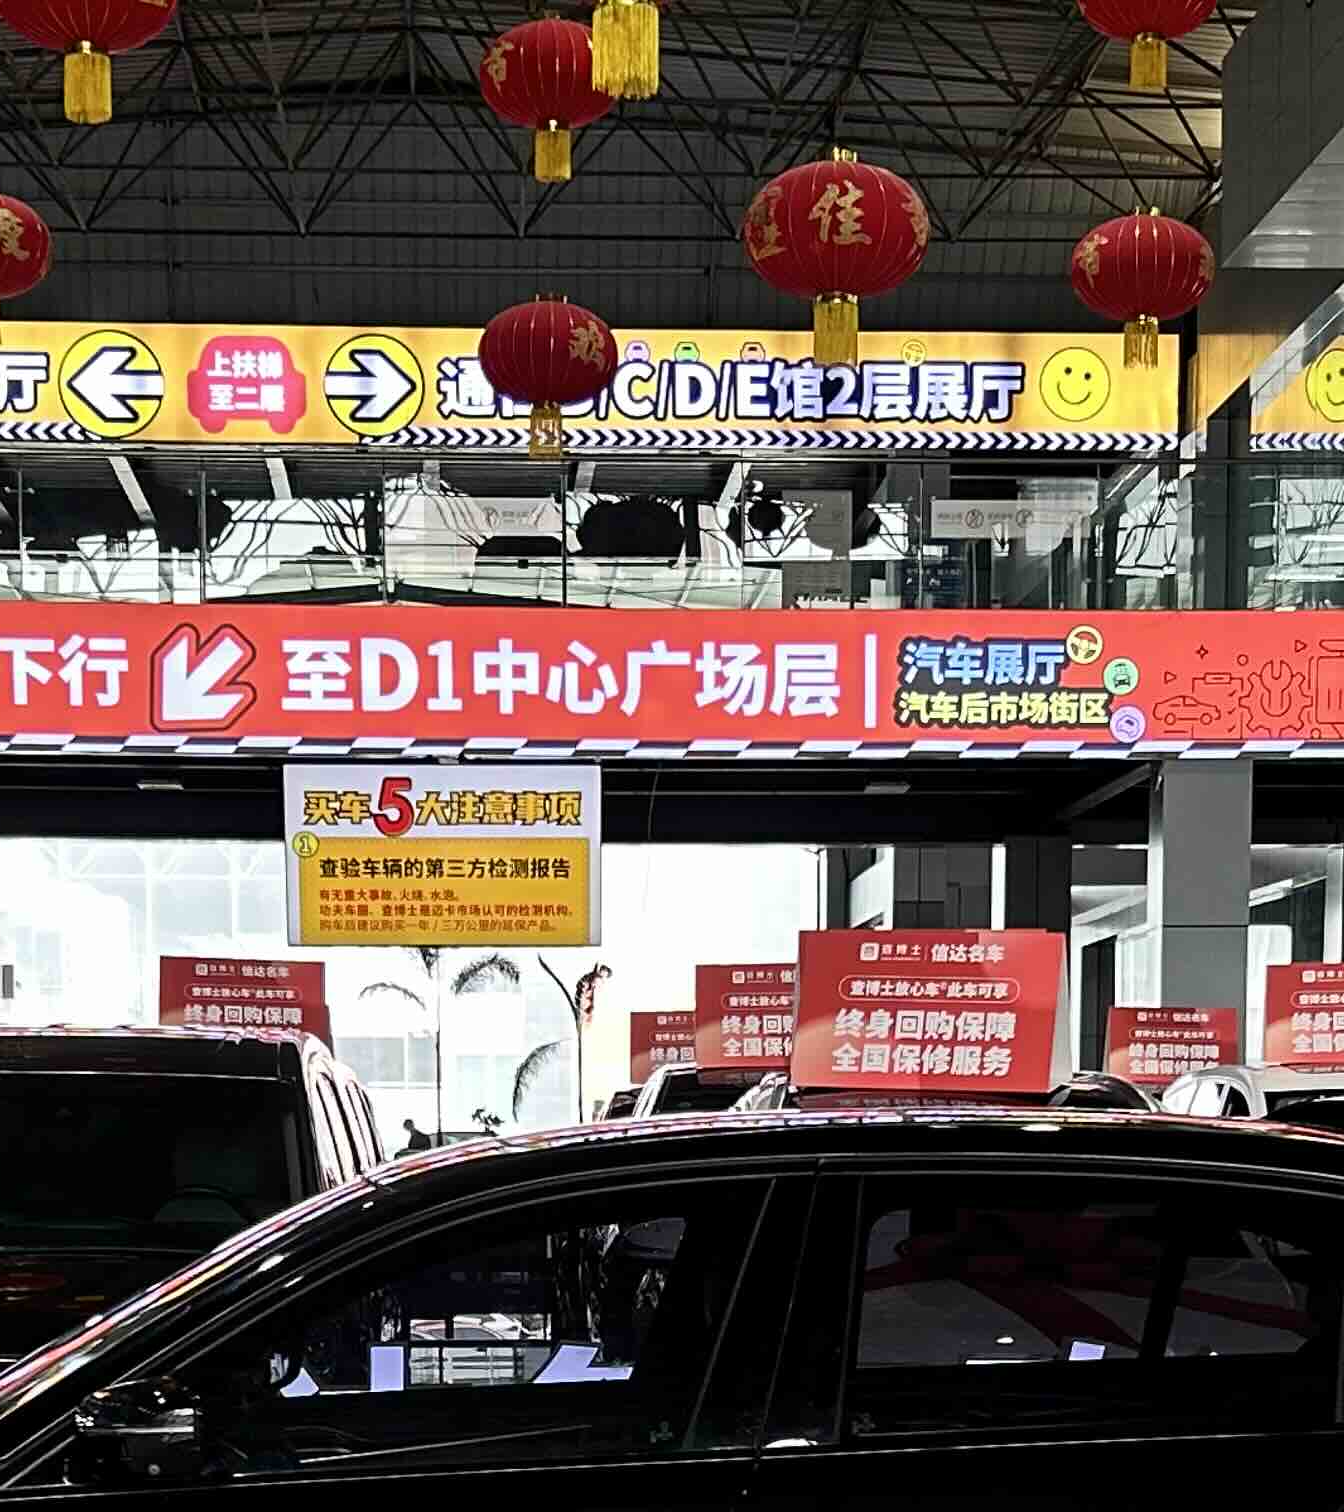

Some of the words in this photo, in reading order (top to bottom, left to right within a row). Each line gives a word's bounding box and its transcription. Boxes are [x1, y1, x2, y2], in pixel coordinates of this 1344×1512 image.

[808, 179, 873, 245] 佳
[205, 349, 284, 380] 上扶梯
[208, 383, 286, 414] 至二层
[280, 637, 842, 719] 至D1中心广场层
[901, 639, 1067, 687] 汽车展厅
[897, 689, 1111, 728] 汽车后市场街区
[303, 776, 583, 837] 买车5大注意事项
[319, 857, 571, 880] 查验车辆的第三方检测报告
[931, 943, 1005, 963] 信达名车
[184, 1004, 303, 1025] 终身回购保障
[833, 1008, 1017, 1042] 终身回购保障
[831, 1043, 1013, 1077] 全国保修服务
